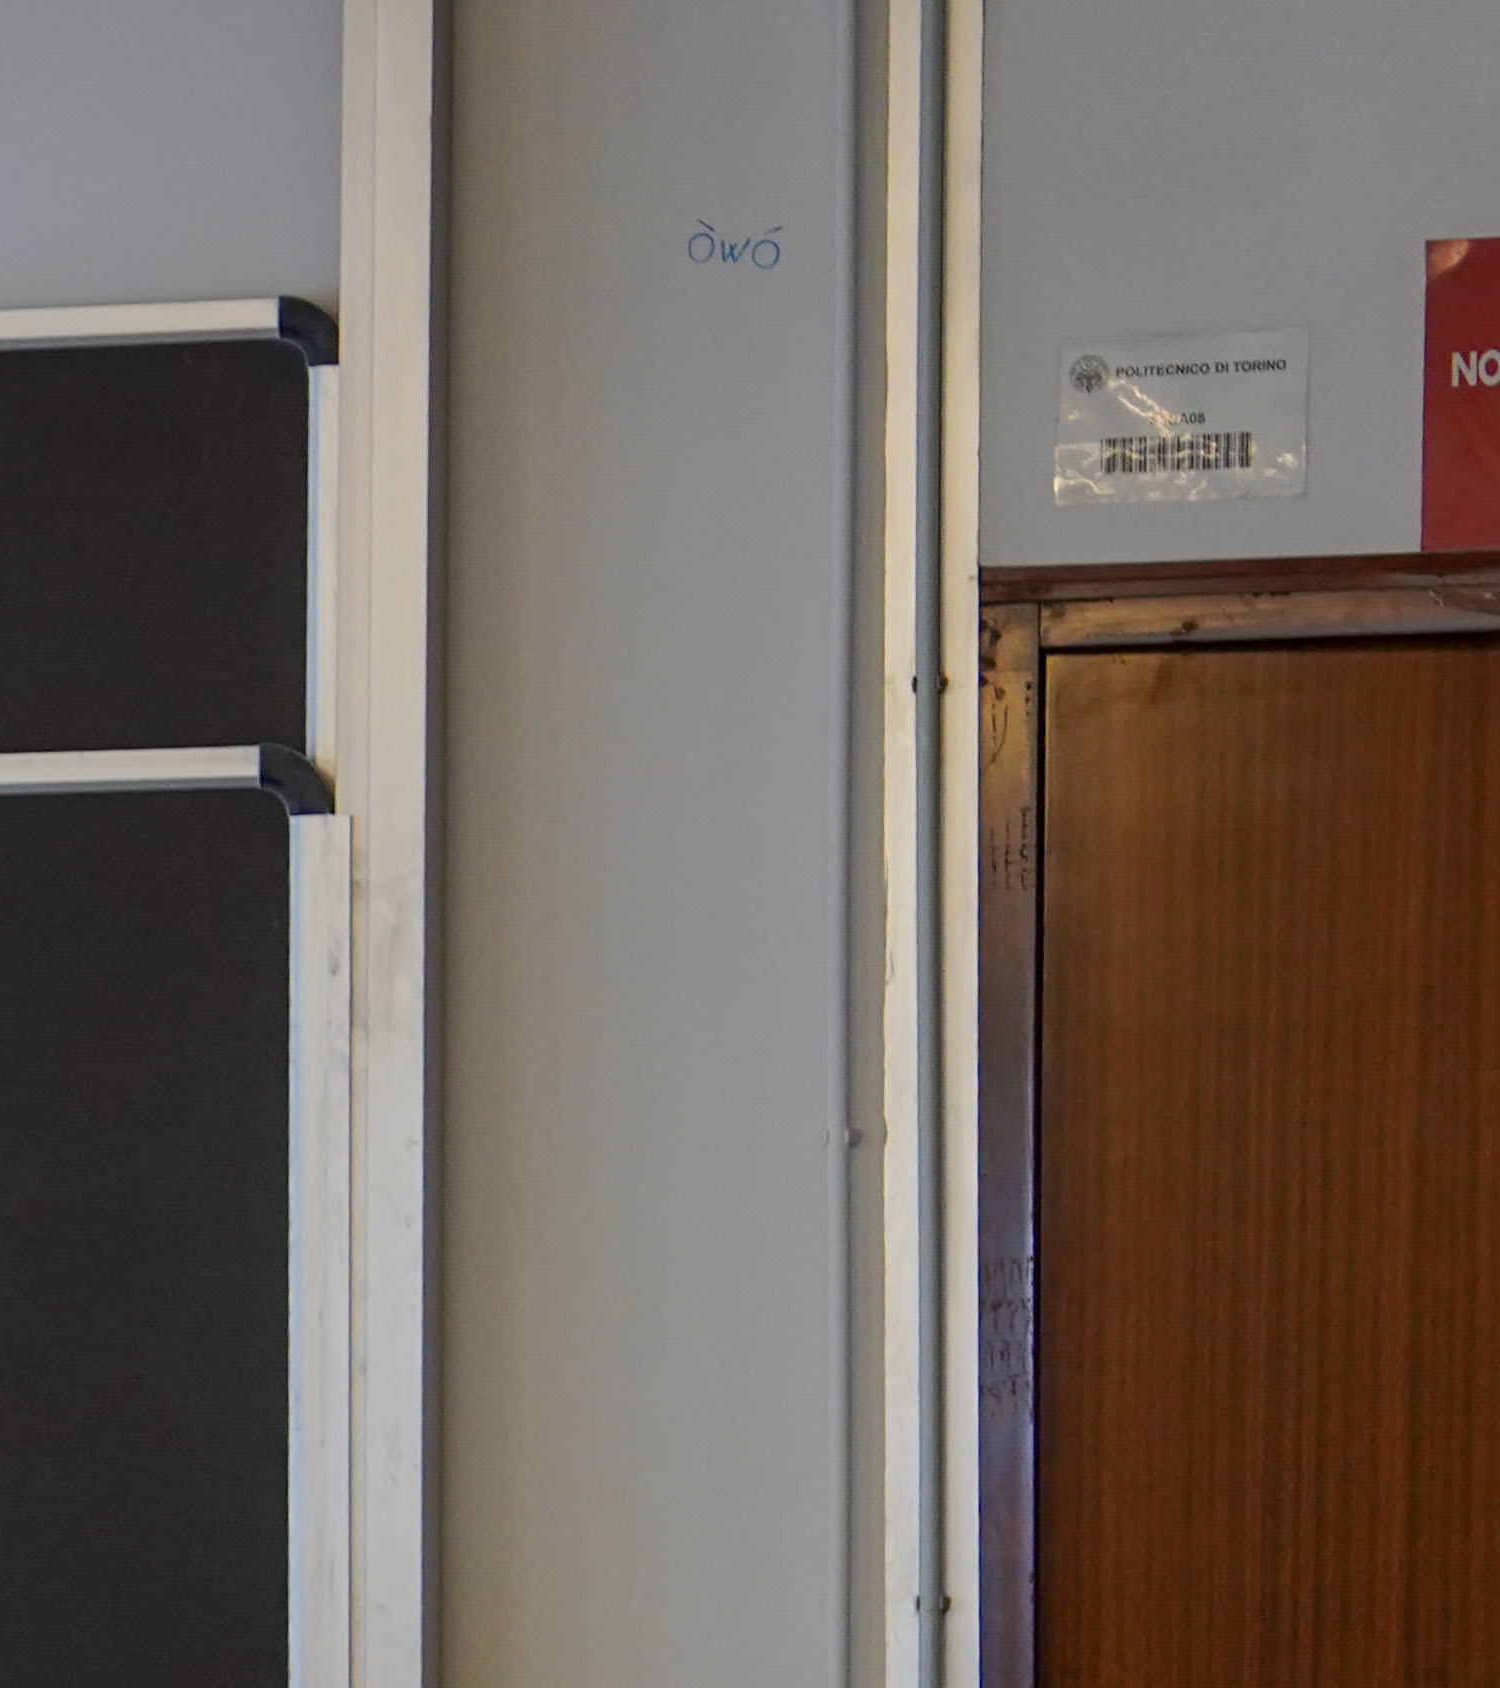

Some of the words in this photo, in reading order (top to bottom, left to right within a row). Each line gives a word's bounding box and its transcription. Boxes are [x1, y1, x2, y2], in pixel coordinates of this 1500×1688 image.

[1116, 362, 1210, 379] POLITECNICO
[1215, 361, 1229, 375] DI
[1233, 359, 1287, 373] TORINO
